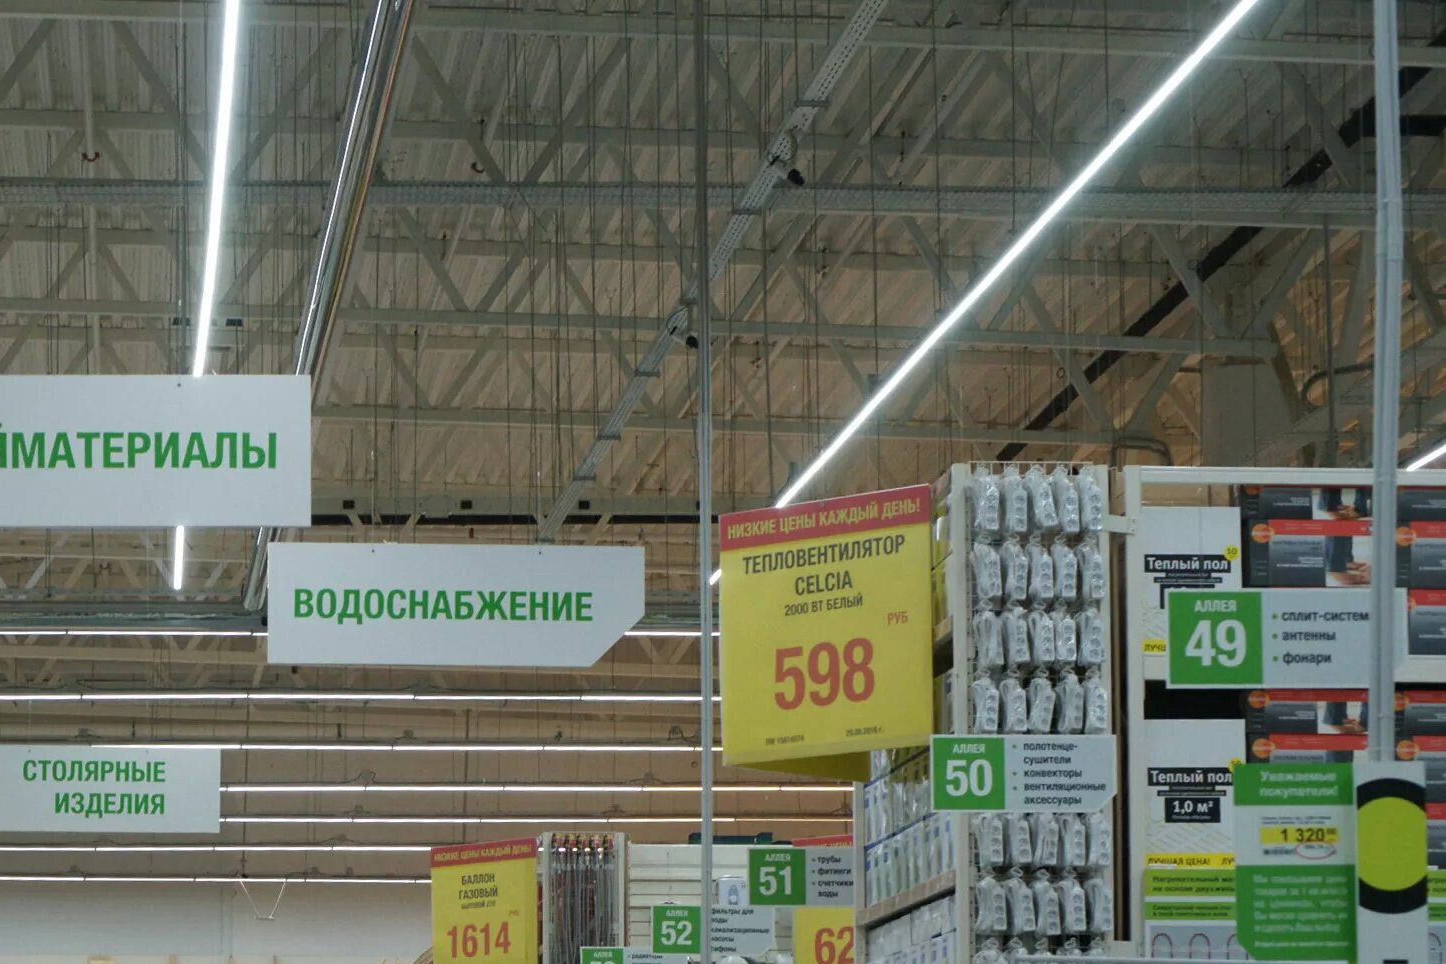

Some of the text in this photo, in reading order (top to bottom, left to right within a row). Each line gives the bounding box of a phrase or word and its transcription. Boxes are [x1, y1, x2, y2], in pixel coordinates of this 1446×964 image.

[728, 497, 920, 540] НИЗКИЕ ЦЕНЫ КАЖДЫЙ ДЕНЬ!
[742, 534, 906, 576] ТЕПЛОВЕНТИЛЯТОР
[1147, 557, 1229, 570] Теплый пол
[794, 570, 853, 596] CELCIA
[293, 589, 593, 624] ВОДОСНАБЖЕНИЕ
[784, 592, 863, 617] 2000 ВТ БЕЛЫЙ
[1194, 600, 1237, 612] АЛЛЕЯ
[887, 610, 908, 626] РУБ
[1281, 612, 1370, 623] сплит-систем
[1185, 619, 1247, 667] 49
[1282, 632, 1336, 641] антенны
[1283, 652, 1332, 666] фонари
[774, 637, 875, 711] 598
[953, 744, 985, 753] АЛЛЕЯ
[1023, 743, 1078, 752] полотенце-
[1023, 756, 1071, 765] сушители
[22, 759, 166, 783] СТОЛЯРНЫЕ
[946, 759, 992, 797] 50
[1024, 770, 1082, 778] конвекторы
[1150, 770, 1233, 783] Теплый пол
[1024, 783, 1106, 792] вентиляционные
[1260, 785, 1339, 797] покупатели!
[54, 791, 165, 816] ИЗДЕЛИЯ
[1024, 797, 1081, 805] аксессуары
[1172, 801, 1193, 813] 1,0
[1281, 828, 1325, 842] 1 320
[764, 853, 791, 861] АЛЛЕЯ
[817, 856, 841, 864] трубы
[461, 873, 495, 886] БАЛЛОН
[758, 866, 792, 895] 51
[458, 885, 498, 900] ГАЗОВЫЙ
[447, 921, 511, 958] 1614
[660, 920, 692, 945] 52
